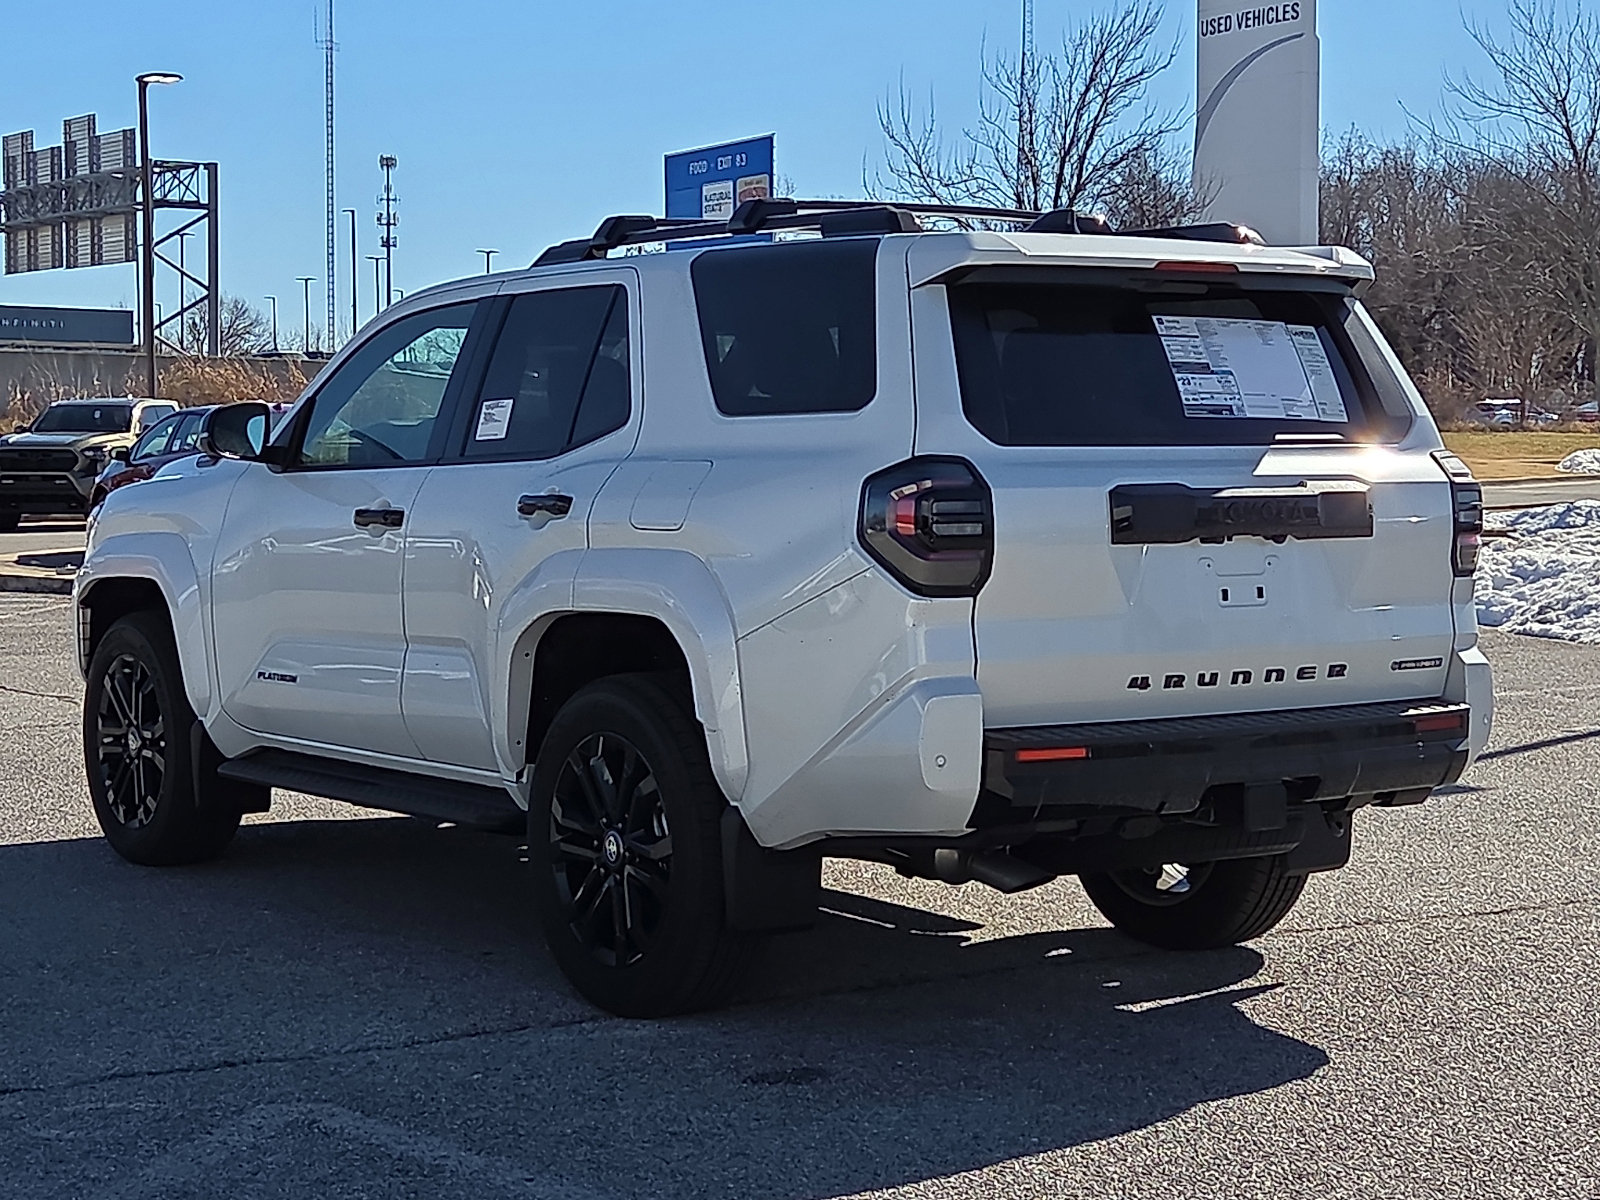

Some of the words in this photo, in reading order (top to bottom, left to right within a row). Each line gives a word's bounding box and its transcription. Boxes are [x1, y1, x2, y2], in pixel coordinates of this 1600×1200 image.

[1201, 15, 1232, 37] USED
[1236, 2, 1300, 30] VEHICLES
[689, 160, 708, 175] FOOD
[717, 155, 732, 170] EXIT
[735, 153, 747, 167] 83
[1211, 500, 1307, 522] TOYOTA
[1127, 663, 1348, 691] 4RUNNER
